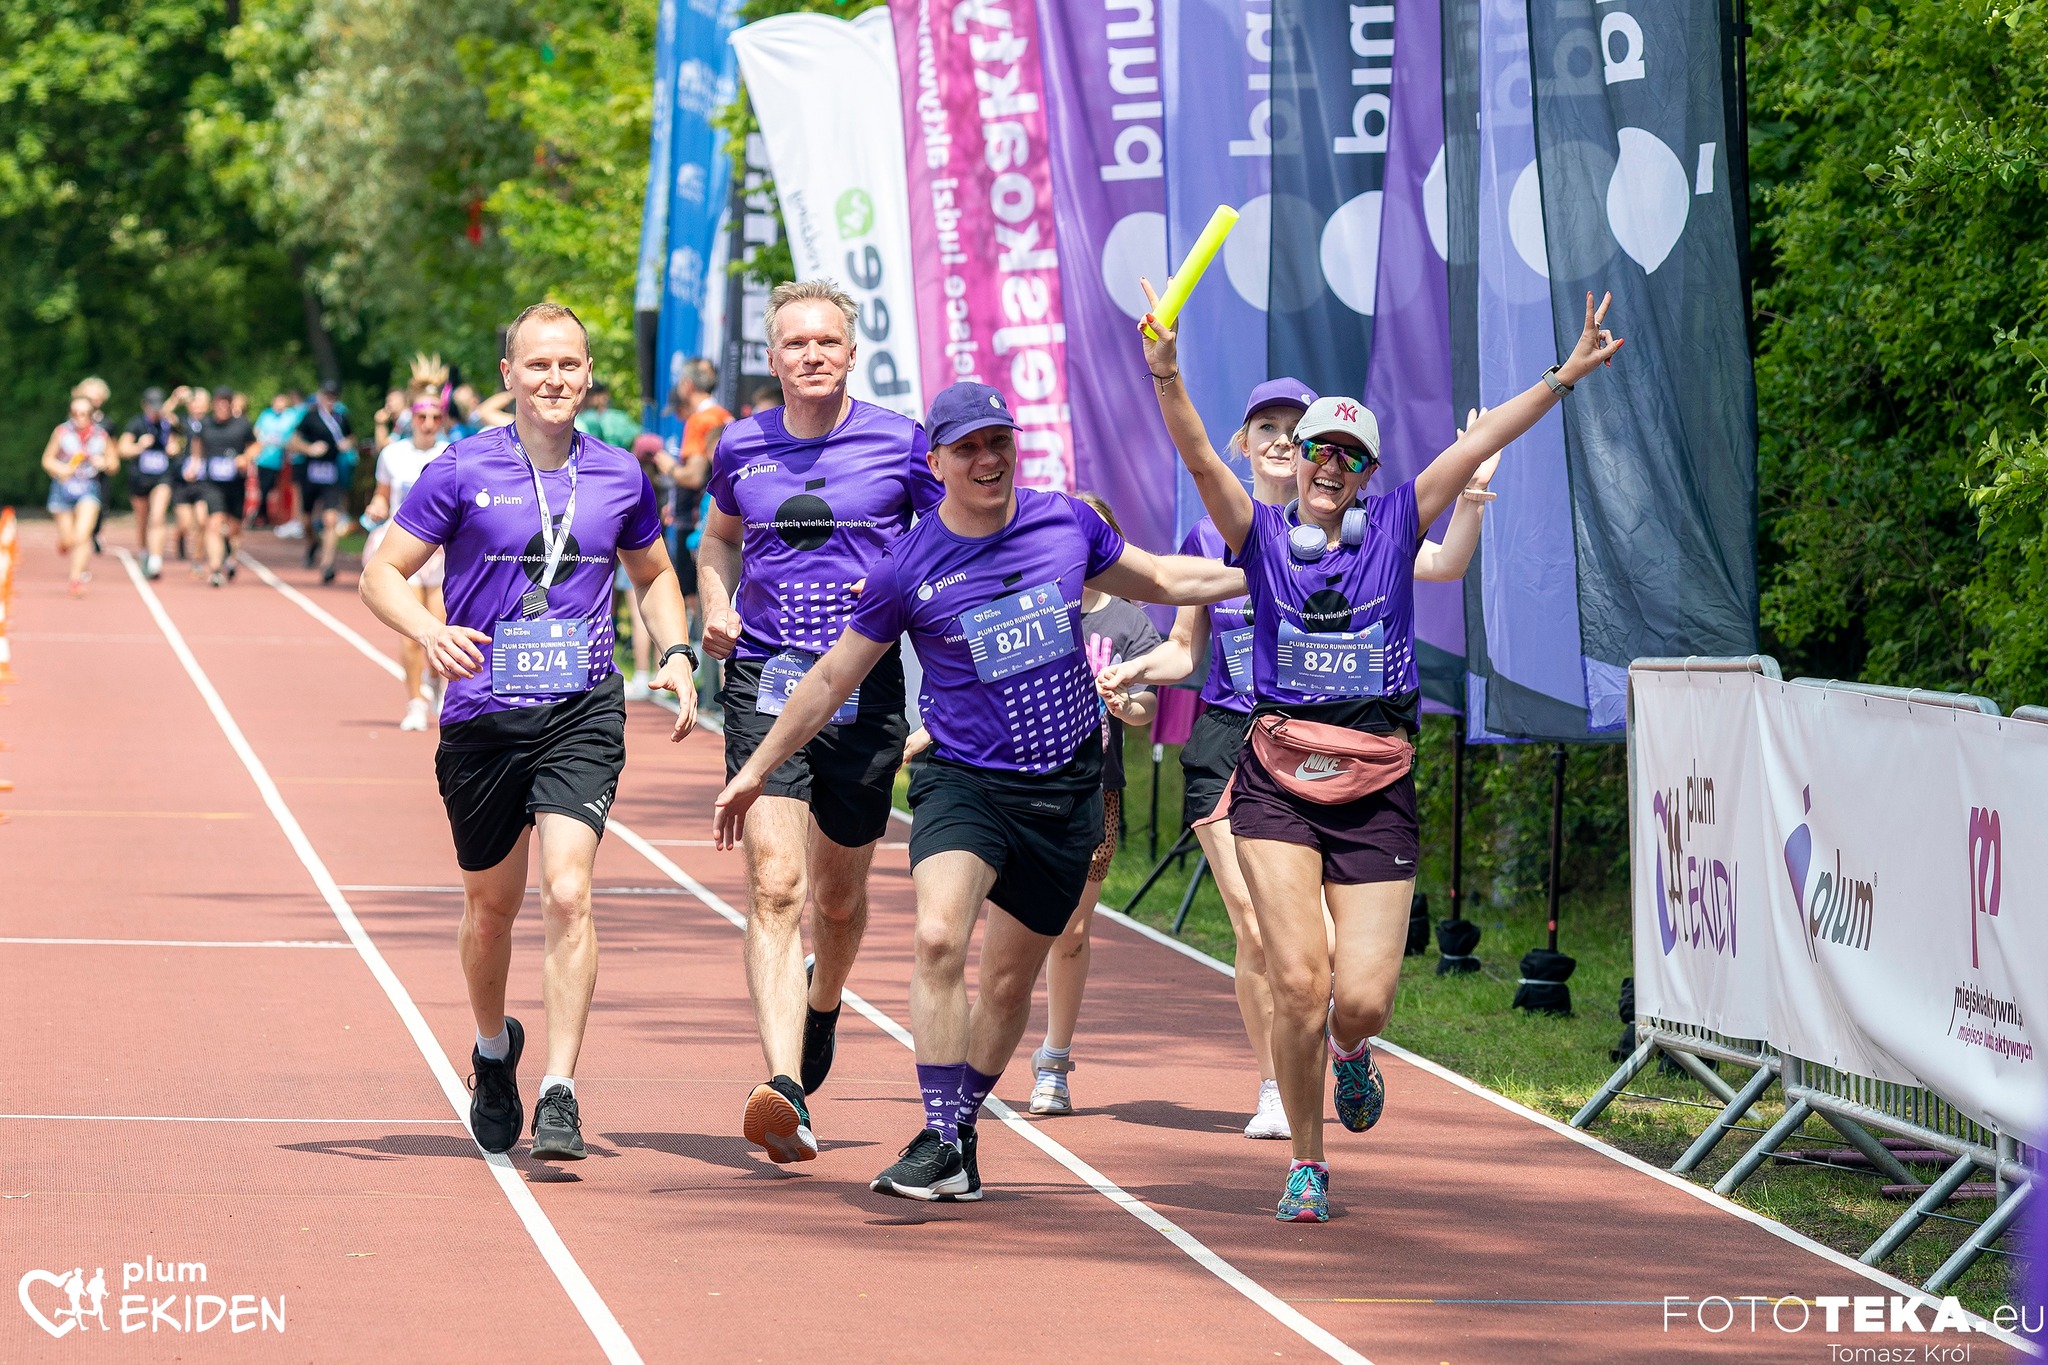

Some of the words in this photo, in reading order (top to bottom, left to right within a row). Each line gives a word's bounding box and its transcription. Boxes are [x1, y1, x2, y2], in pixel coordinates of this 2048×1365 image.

[751, 464, 777, 477] plum
[493, 494, 523, 507] plum
[770, 519, 800, 530] częścią
[801, 519, 835, 527] wielkich
[935, 571, 967, 593] plum
[1324, 609, 1353, 620] wielkich
[1352, 594, 1386, 615] projektów
[977, 627, 993, 637] PLUM
[1014, 611, 1040, 624] RUNNING
[1039, 605, 1056, 615] TEAM
[996, 620, 1045, 654] 82/1
[517, 650, 568, 672] 82/4
[772, 666, 788, 675] PLUM
[1303, 651, 1358, 673] 82/6
[1304, 753, 1341, 772] NIKE
[1687, 758, 1715, 842] plum
[1956, 1022, 1984, 1047] miejsce
[1995, 1033, 2033, 1063] aktywnych
